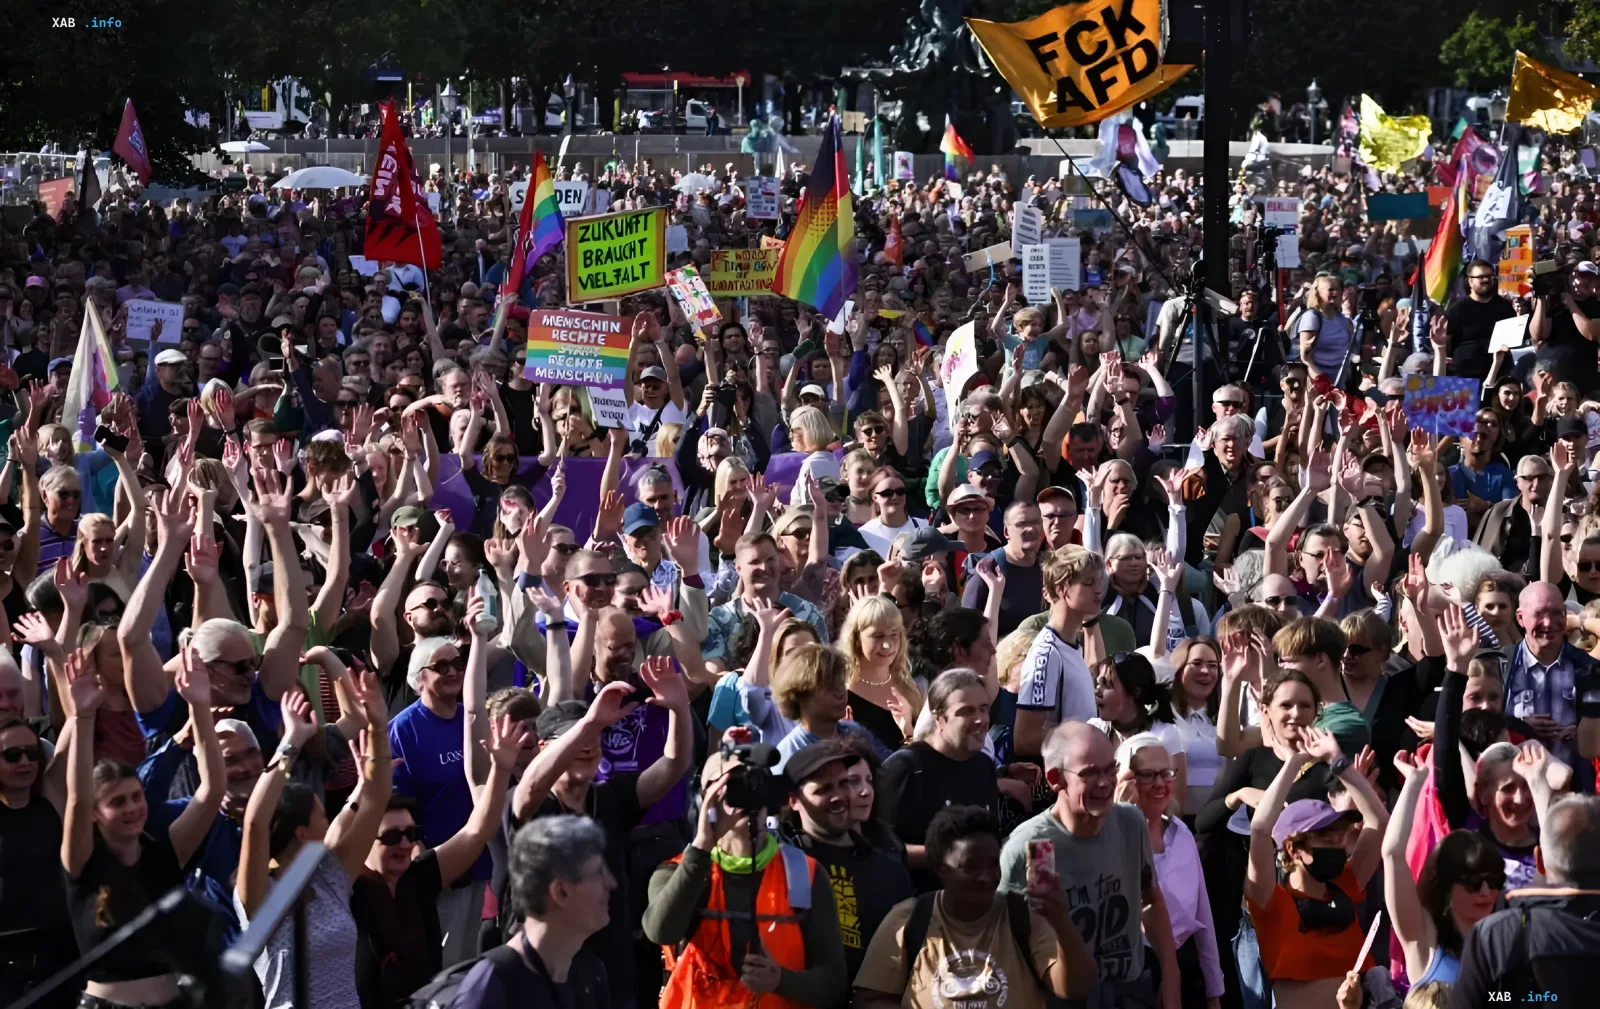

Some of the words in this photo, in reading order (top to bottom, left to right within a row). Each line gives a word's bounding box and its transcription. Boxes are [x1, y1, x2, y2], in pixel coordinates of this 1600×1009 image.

[1024, 0, 1146, 78] FCK
[1056, 38, 1158, 114] AFD
[515, 188, 582, 205] SDEN
[578, 212, 653, 243] ZUKUNFT
[583, 237, 648, 268] BRAUCHT
[578, 260, 651, 290] VIELFALT
[552, 329, 607, 346] RECHTE
[535, 366, 613, 385] MENSCHEN
